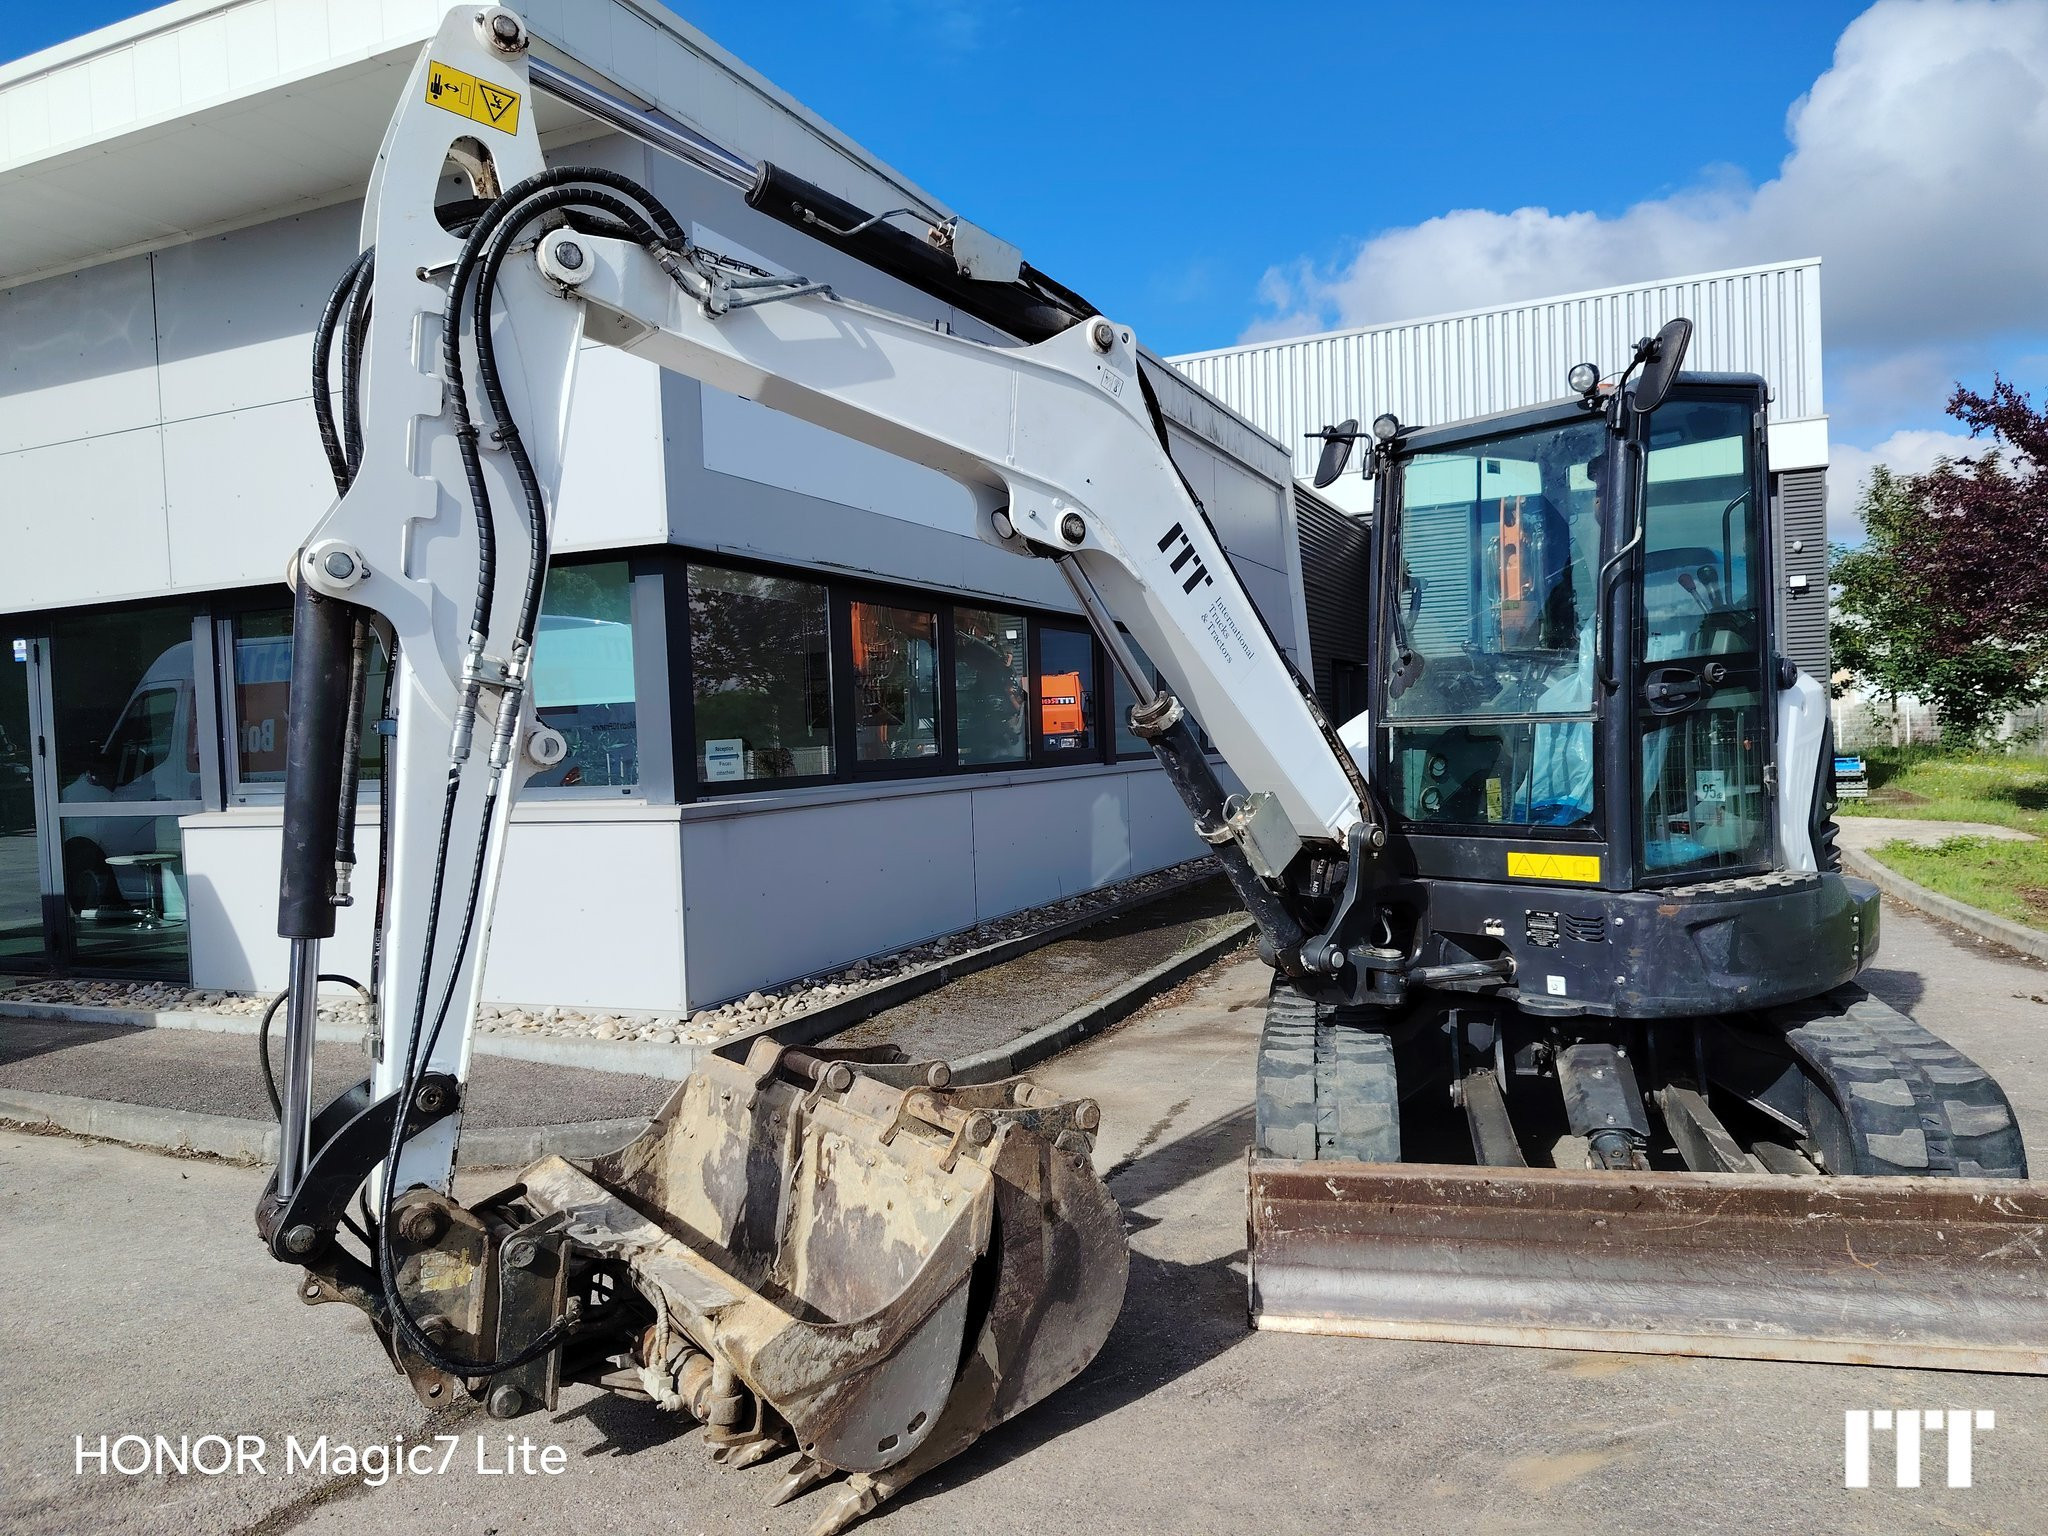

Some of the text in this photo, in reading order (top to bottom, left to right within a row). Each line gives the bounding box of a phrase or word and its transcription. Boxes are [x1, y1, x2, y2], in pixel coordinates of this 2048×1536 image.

[1201, 613, 1233, 663] & Tractors
[1207, 603, 1230, 640] Trucks
[1215, 596, 1254, 660] International
[1702, 784, 1717, 799] 95
